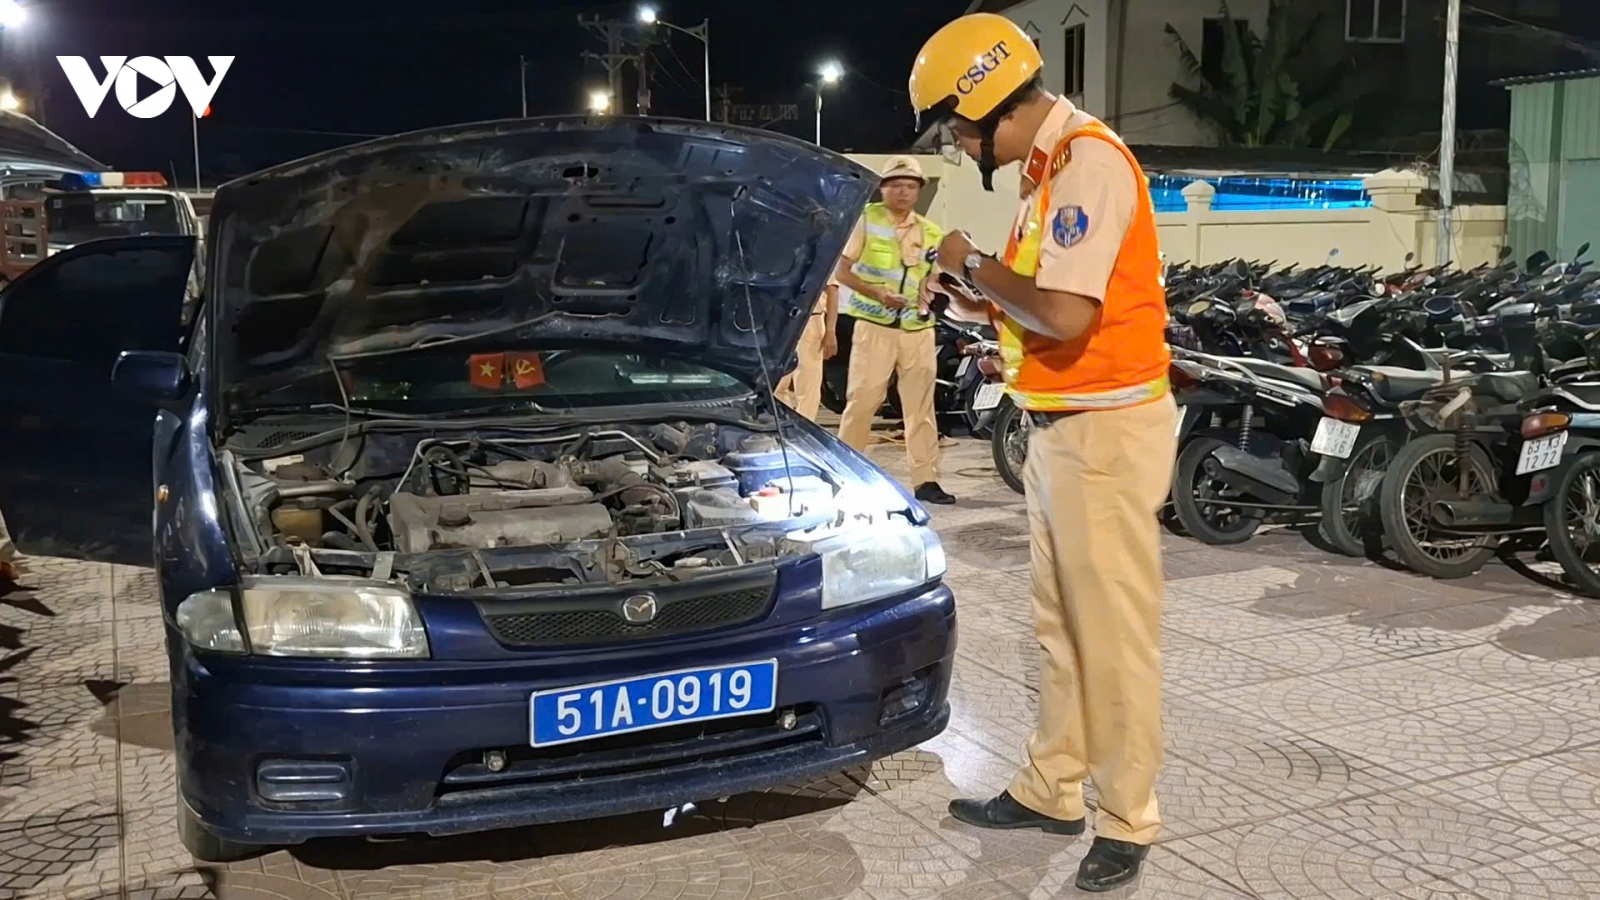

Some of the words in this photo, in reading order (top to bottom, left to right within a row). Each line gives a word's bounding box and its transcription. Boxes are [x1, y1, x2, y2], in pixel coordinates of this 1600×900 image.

[956, 40, 1011, 94] CSGT
[1525, 450, 1557, 471] 1272
[557, 669, 752, 735] 51A-0919
